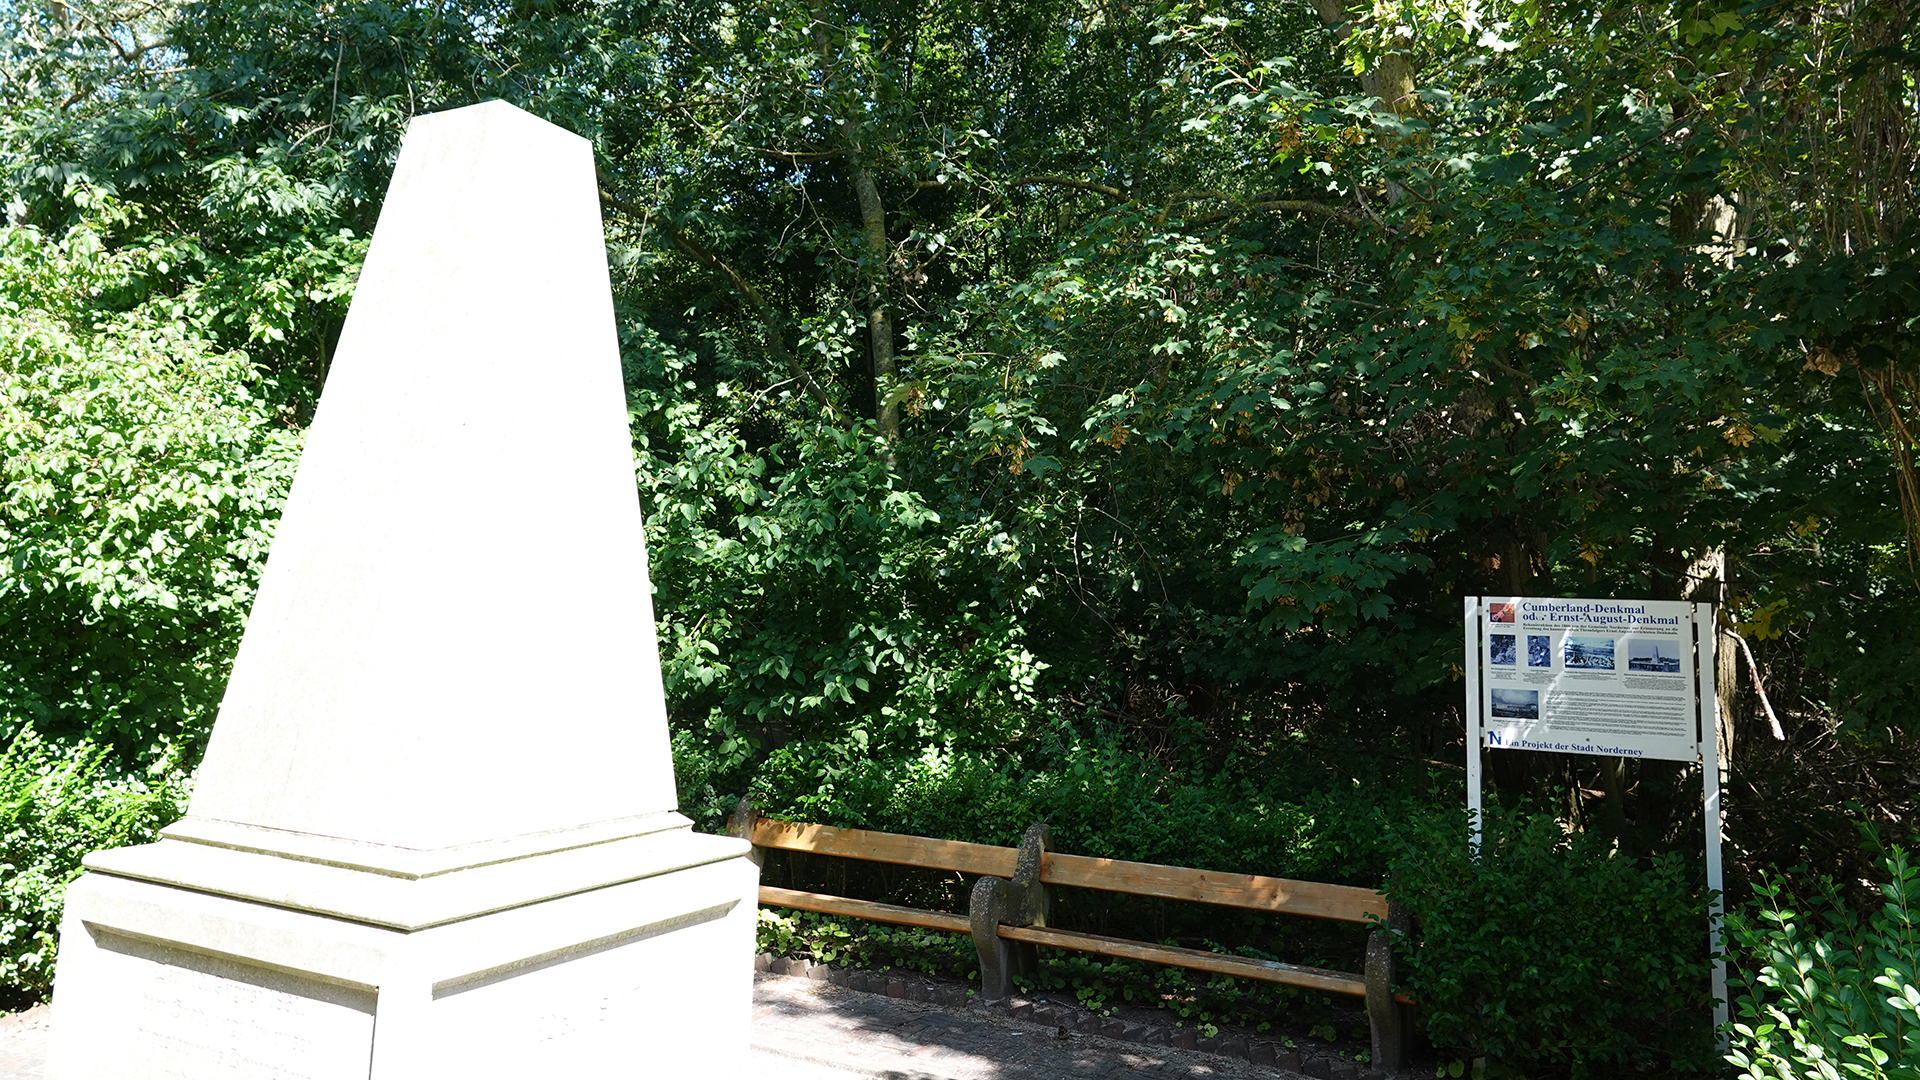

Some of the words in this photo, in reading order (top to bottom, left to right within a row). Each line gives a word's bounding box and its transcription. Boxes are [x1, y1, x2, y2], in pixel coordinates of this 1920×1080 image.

[1522, 602, 1645, 614] Cumberland-Denkmal
[1550, 612, 1679, 625] Ernst-August-Denkmal
[1522, 740, 1552, 750] Projekt
[1571, 743, 1594, 752] Stadt
[1596, 745, 1644, 757] Norderney
